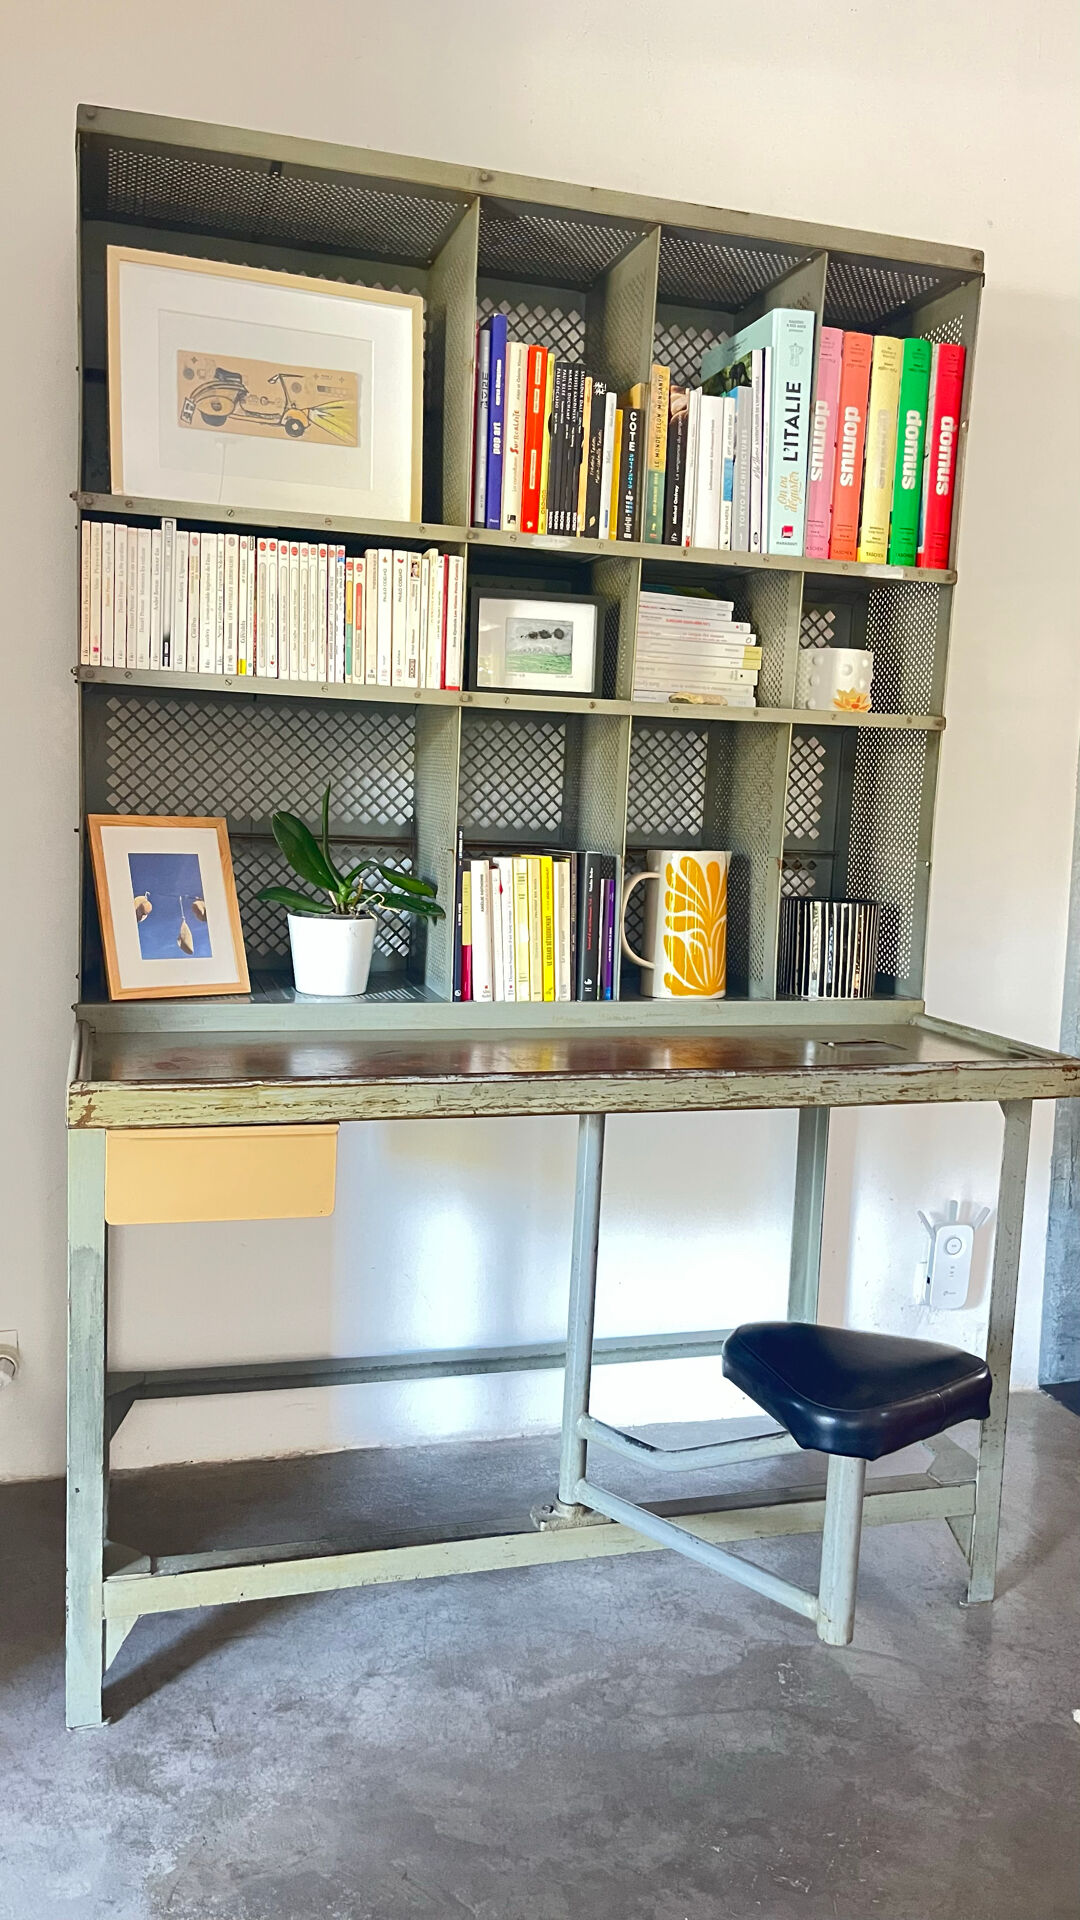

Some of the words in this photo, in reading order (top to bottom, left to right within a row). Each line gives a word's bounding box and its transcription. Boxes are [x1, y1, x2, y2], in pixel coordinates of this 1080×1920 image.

[491, 437, 501, 455] pop
[492, 422, 501, 436] art
[783, 382, 802, 462] L'ITALIE
[810, 400, 830, 482] domus
[839, 406, 861, 487] domus
[738, 428, 748, 497] ARCHITECTURES
[901, 410, 923, 490] domus
[936, 416, 958, 496] domus
[777, 490, 788, 505] On
[780, 475, 788, 489] va
[784, 471, 803, 513] déguster
[738, 498, 746, 528] TOKYO
